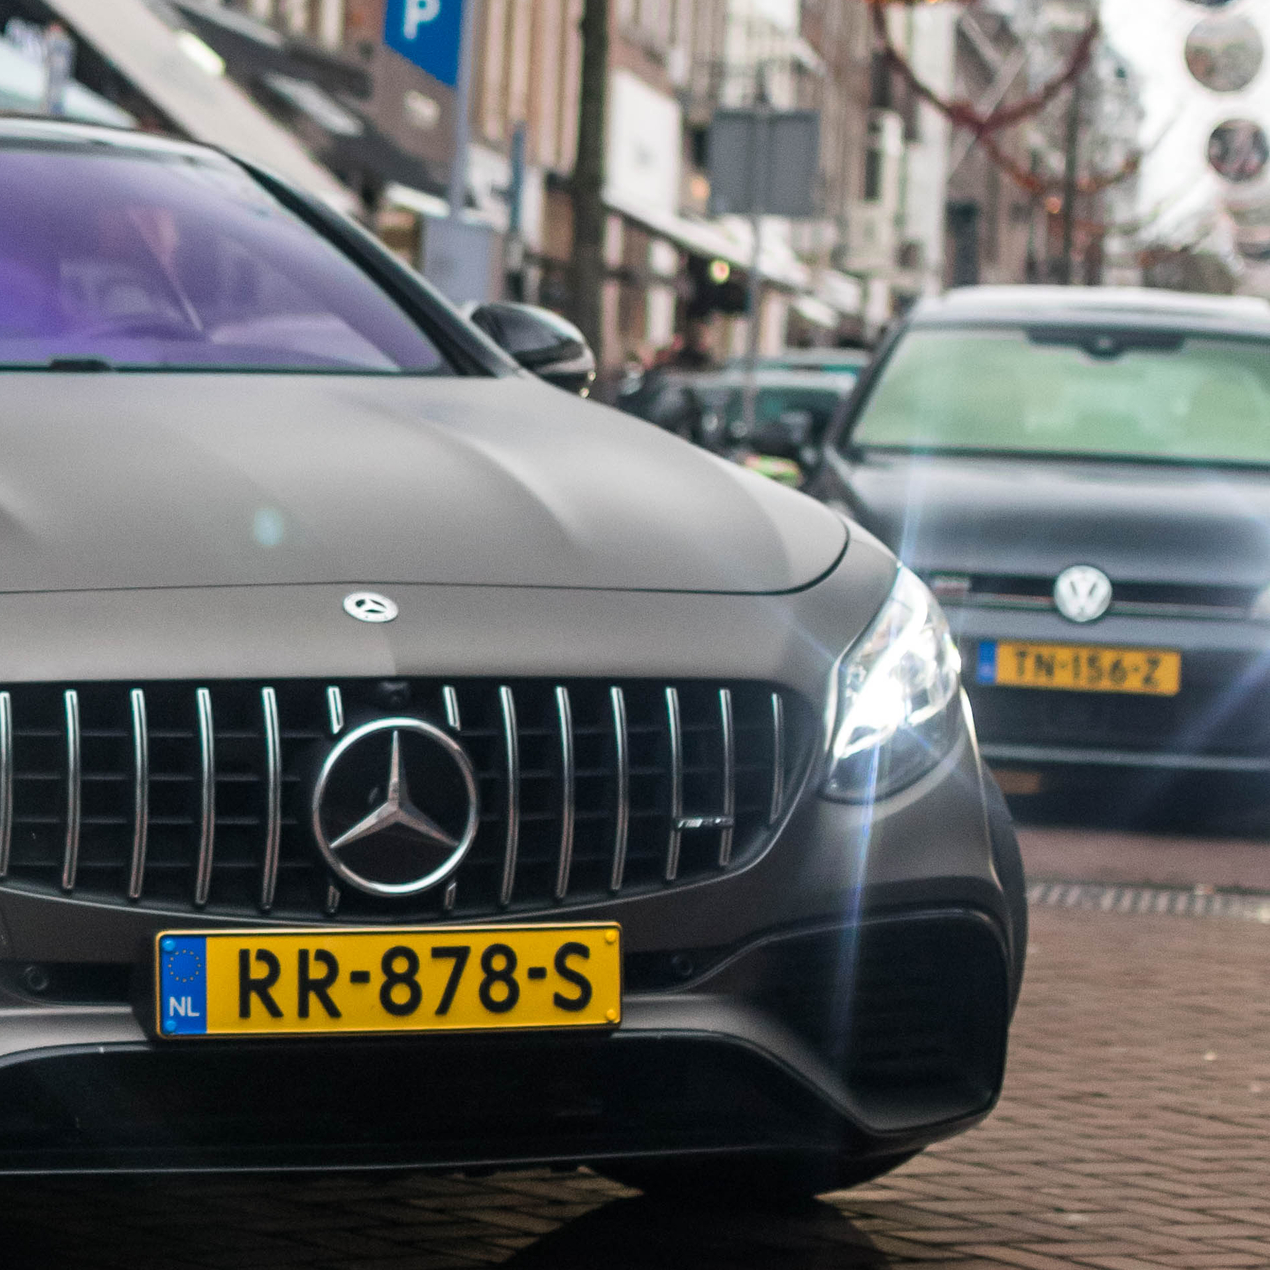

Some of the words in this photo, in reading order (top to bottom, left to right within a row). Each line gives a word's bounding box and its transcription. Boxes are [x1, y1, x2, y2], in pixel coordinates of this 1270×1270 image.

[1016, 648, 1160, 690] TN-156-Z
[237, 942, 593, 1019] RR-878-S
[168, 996, 200, 1018] NL
